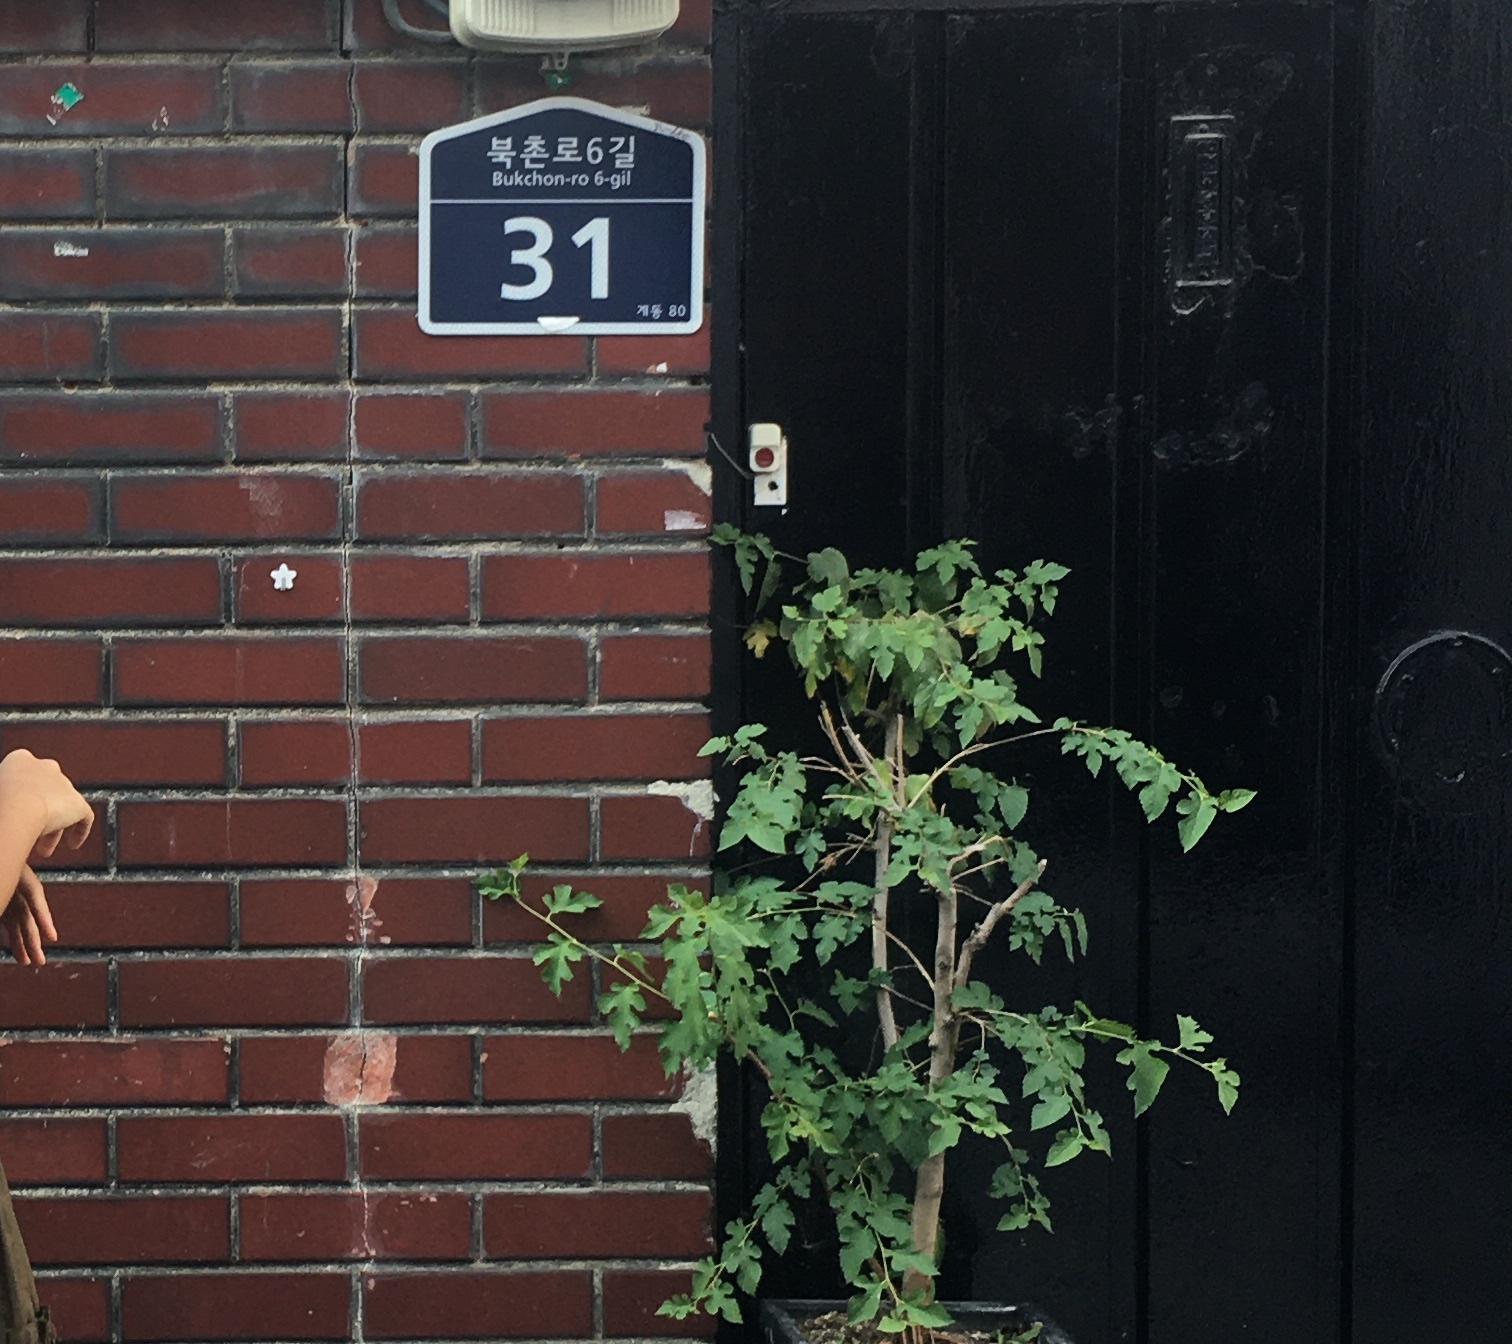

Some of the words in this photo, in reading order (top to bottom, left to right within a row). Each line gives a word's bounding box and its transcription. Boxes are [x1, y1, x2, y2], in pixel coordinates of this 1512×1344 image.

[486, 135, 636, 169] 북촌로6길
[492, 170, 589, 187] Bukchon-ro
[594, 170, 631, 189] 6-gil
[500, 216, 610, 301] 31
[668, 304, 687, 317] 80
